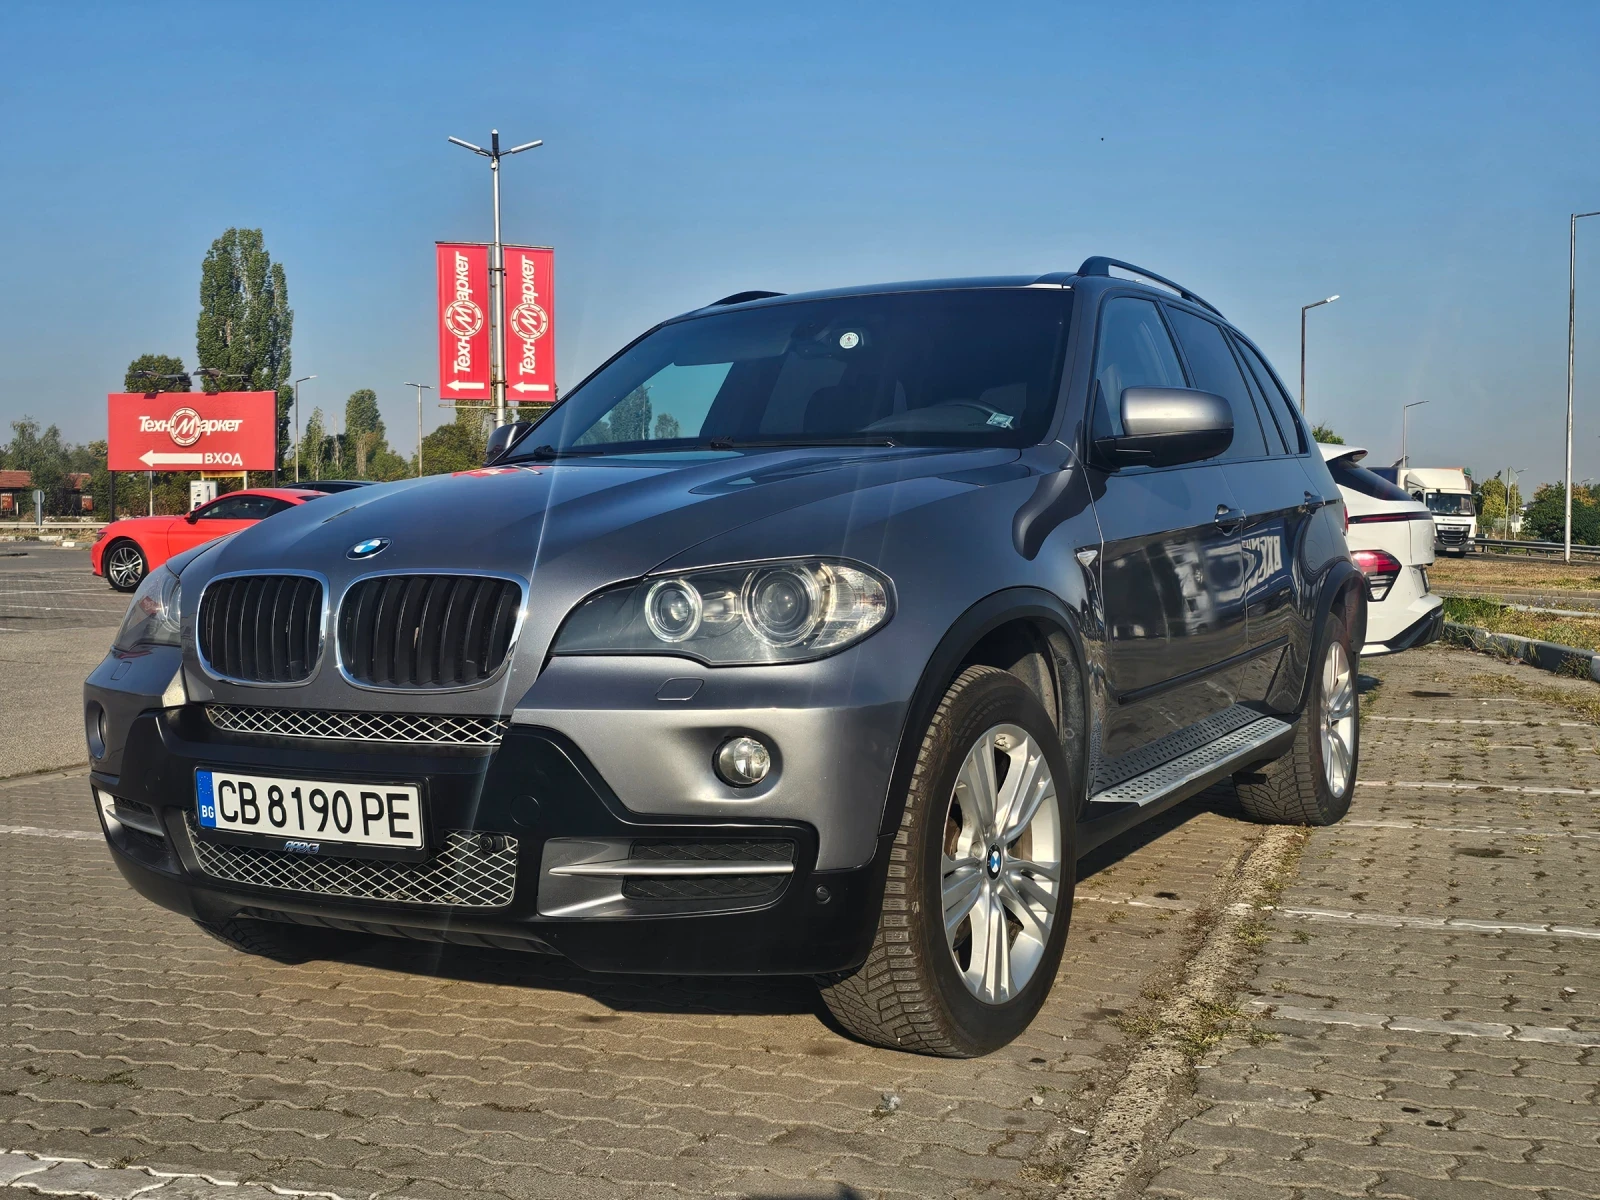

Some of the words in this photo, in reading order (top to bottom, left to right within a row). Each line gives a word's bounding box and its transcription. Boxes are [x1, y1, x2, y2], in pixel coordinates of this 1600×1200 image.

[203, 452, 243, 466] ВХОД
[201, 804, 214, 819] BG
[218, 779, 260, 825] CB
[267, 784, 353, 834] 8190
[360, 791, 413, 839] PE
